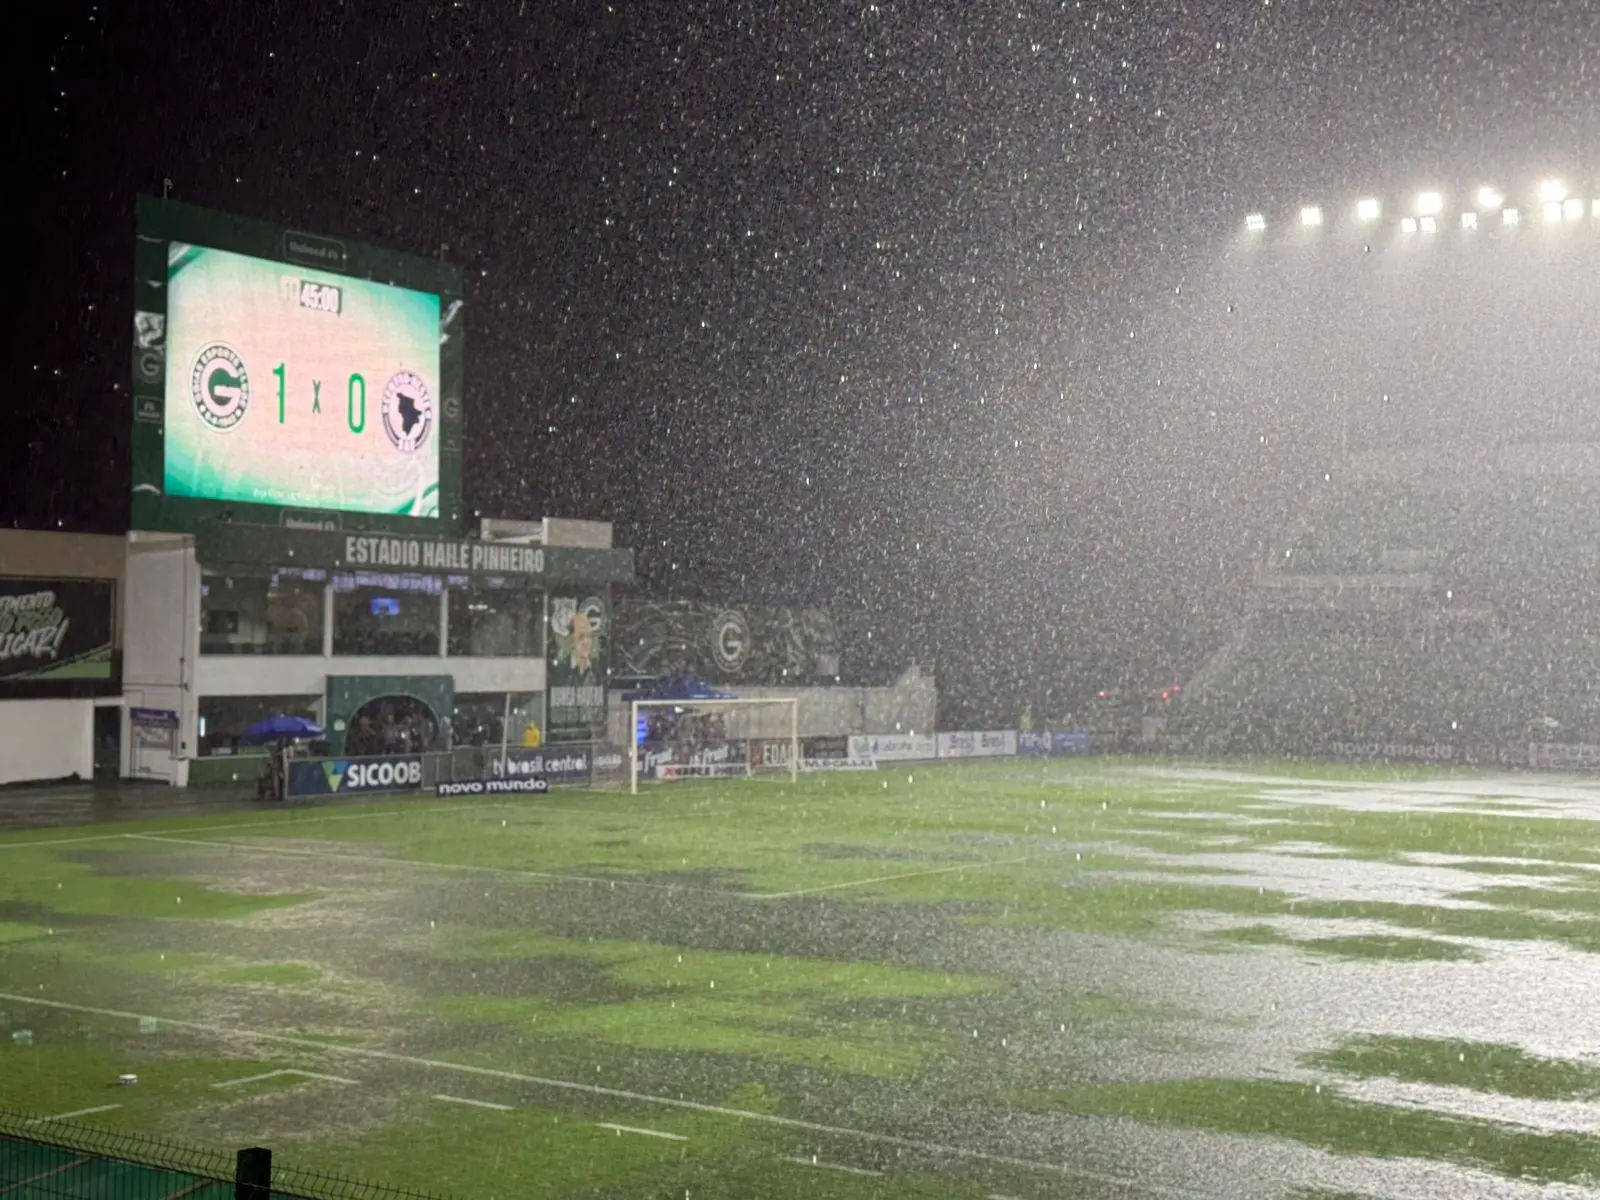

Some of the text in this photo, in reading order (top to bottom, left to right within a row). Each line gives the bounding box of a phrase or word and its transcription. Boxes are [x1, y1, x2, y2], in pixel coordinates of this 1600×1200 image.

[200, 357, 242, 417] G
[272, 361, 285, 424] 1
[348, 372, 366, 434] 0
[471, 544, 545, 573] PINHEIRO
[346, 761, 421, 788] SICOOB
[507, 754, 544, 775] brasil
[545, 753, 588, 774] central
[439, 777, 548, 795] novo mundo
